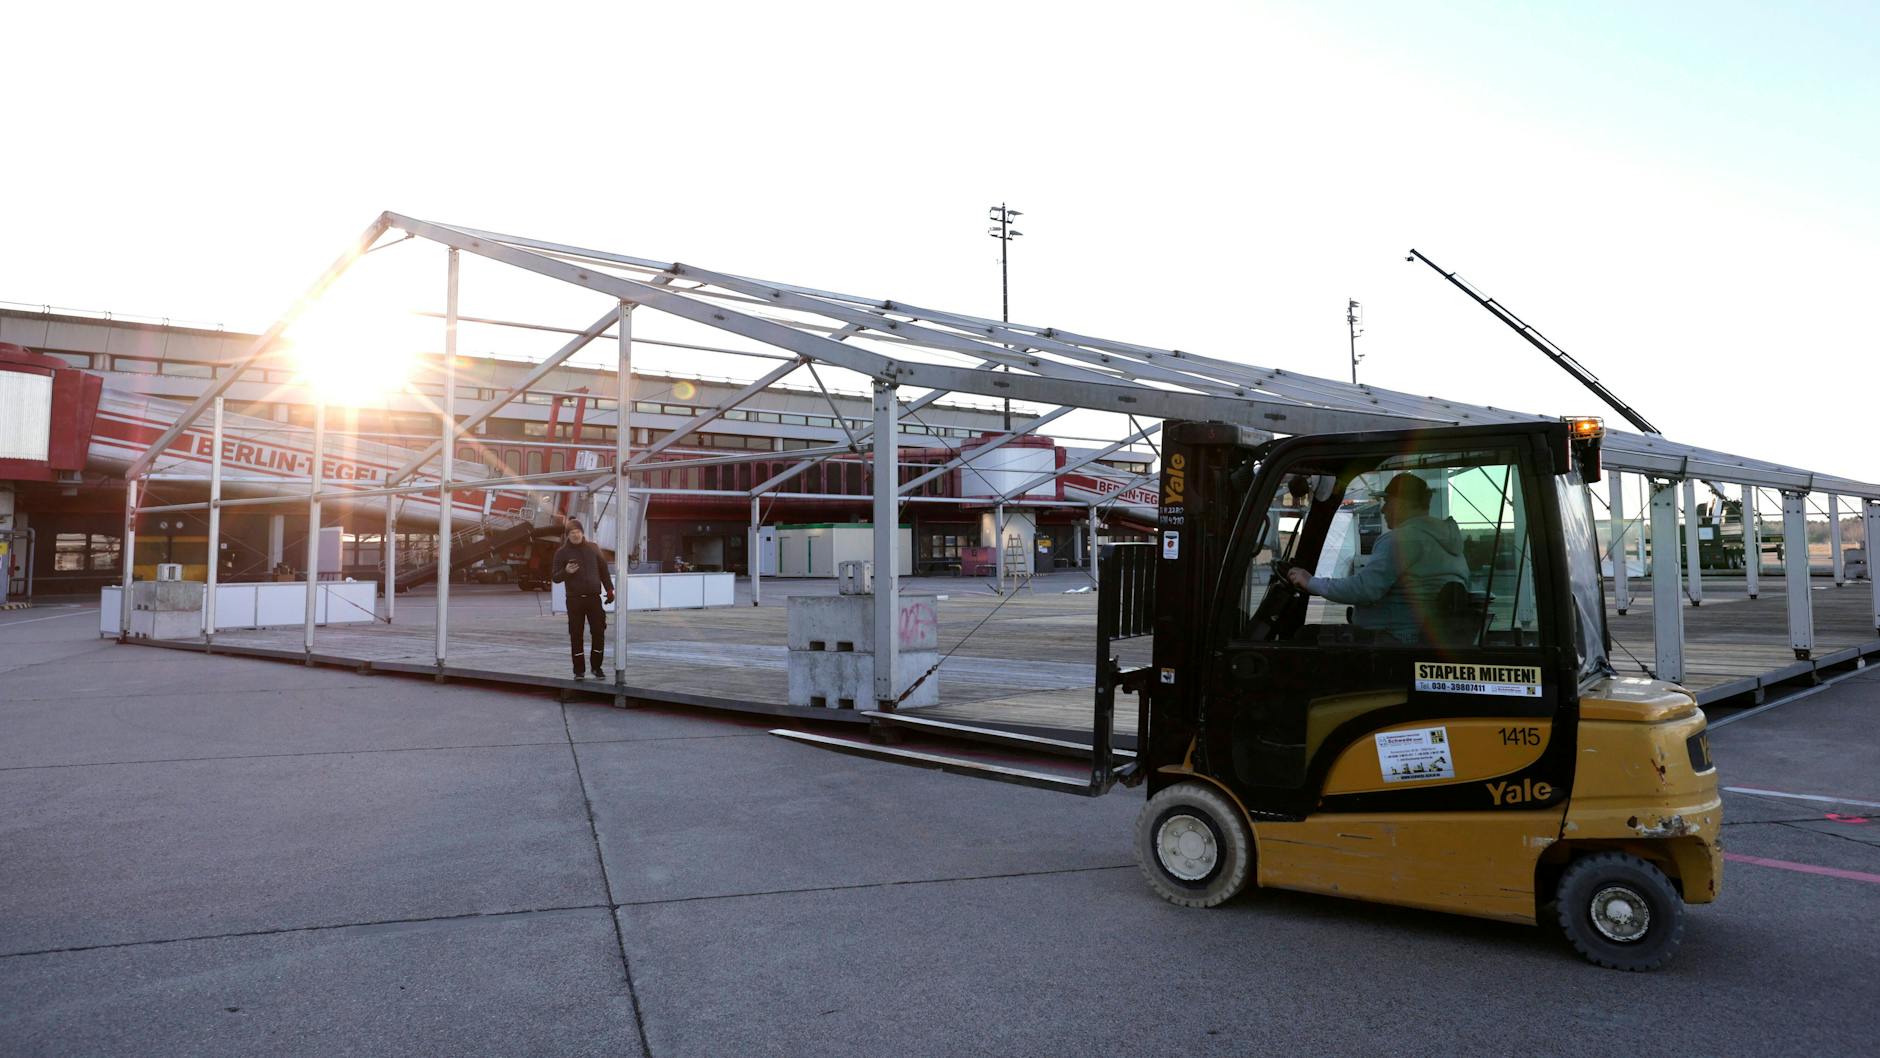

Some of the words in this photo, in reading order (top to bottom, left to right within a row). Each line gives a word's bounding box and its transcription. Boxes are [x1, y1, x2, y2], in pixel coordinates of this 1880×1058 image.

[1165, 453, 1185, 504] Yale
[1420, 664, 1476, 681] STAPLER
[1479, 666, 1536, 684] MIETEN!
[1498, 727, 1541, 746] 1415
[1486, 777, 1552, 806] Yale
